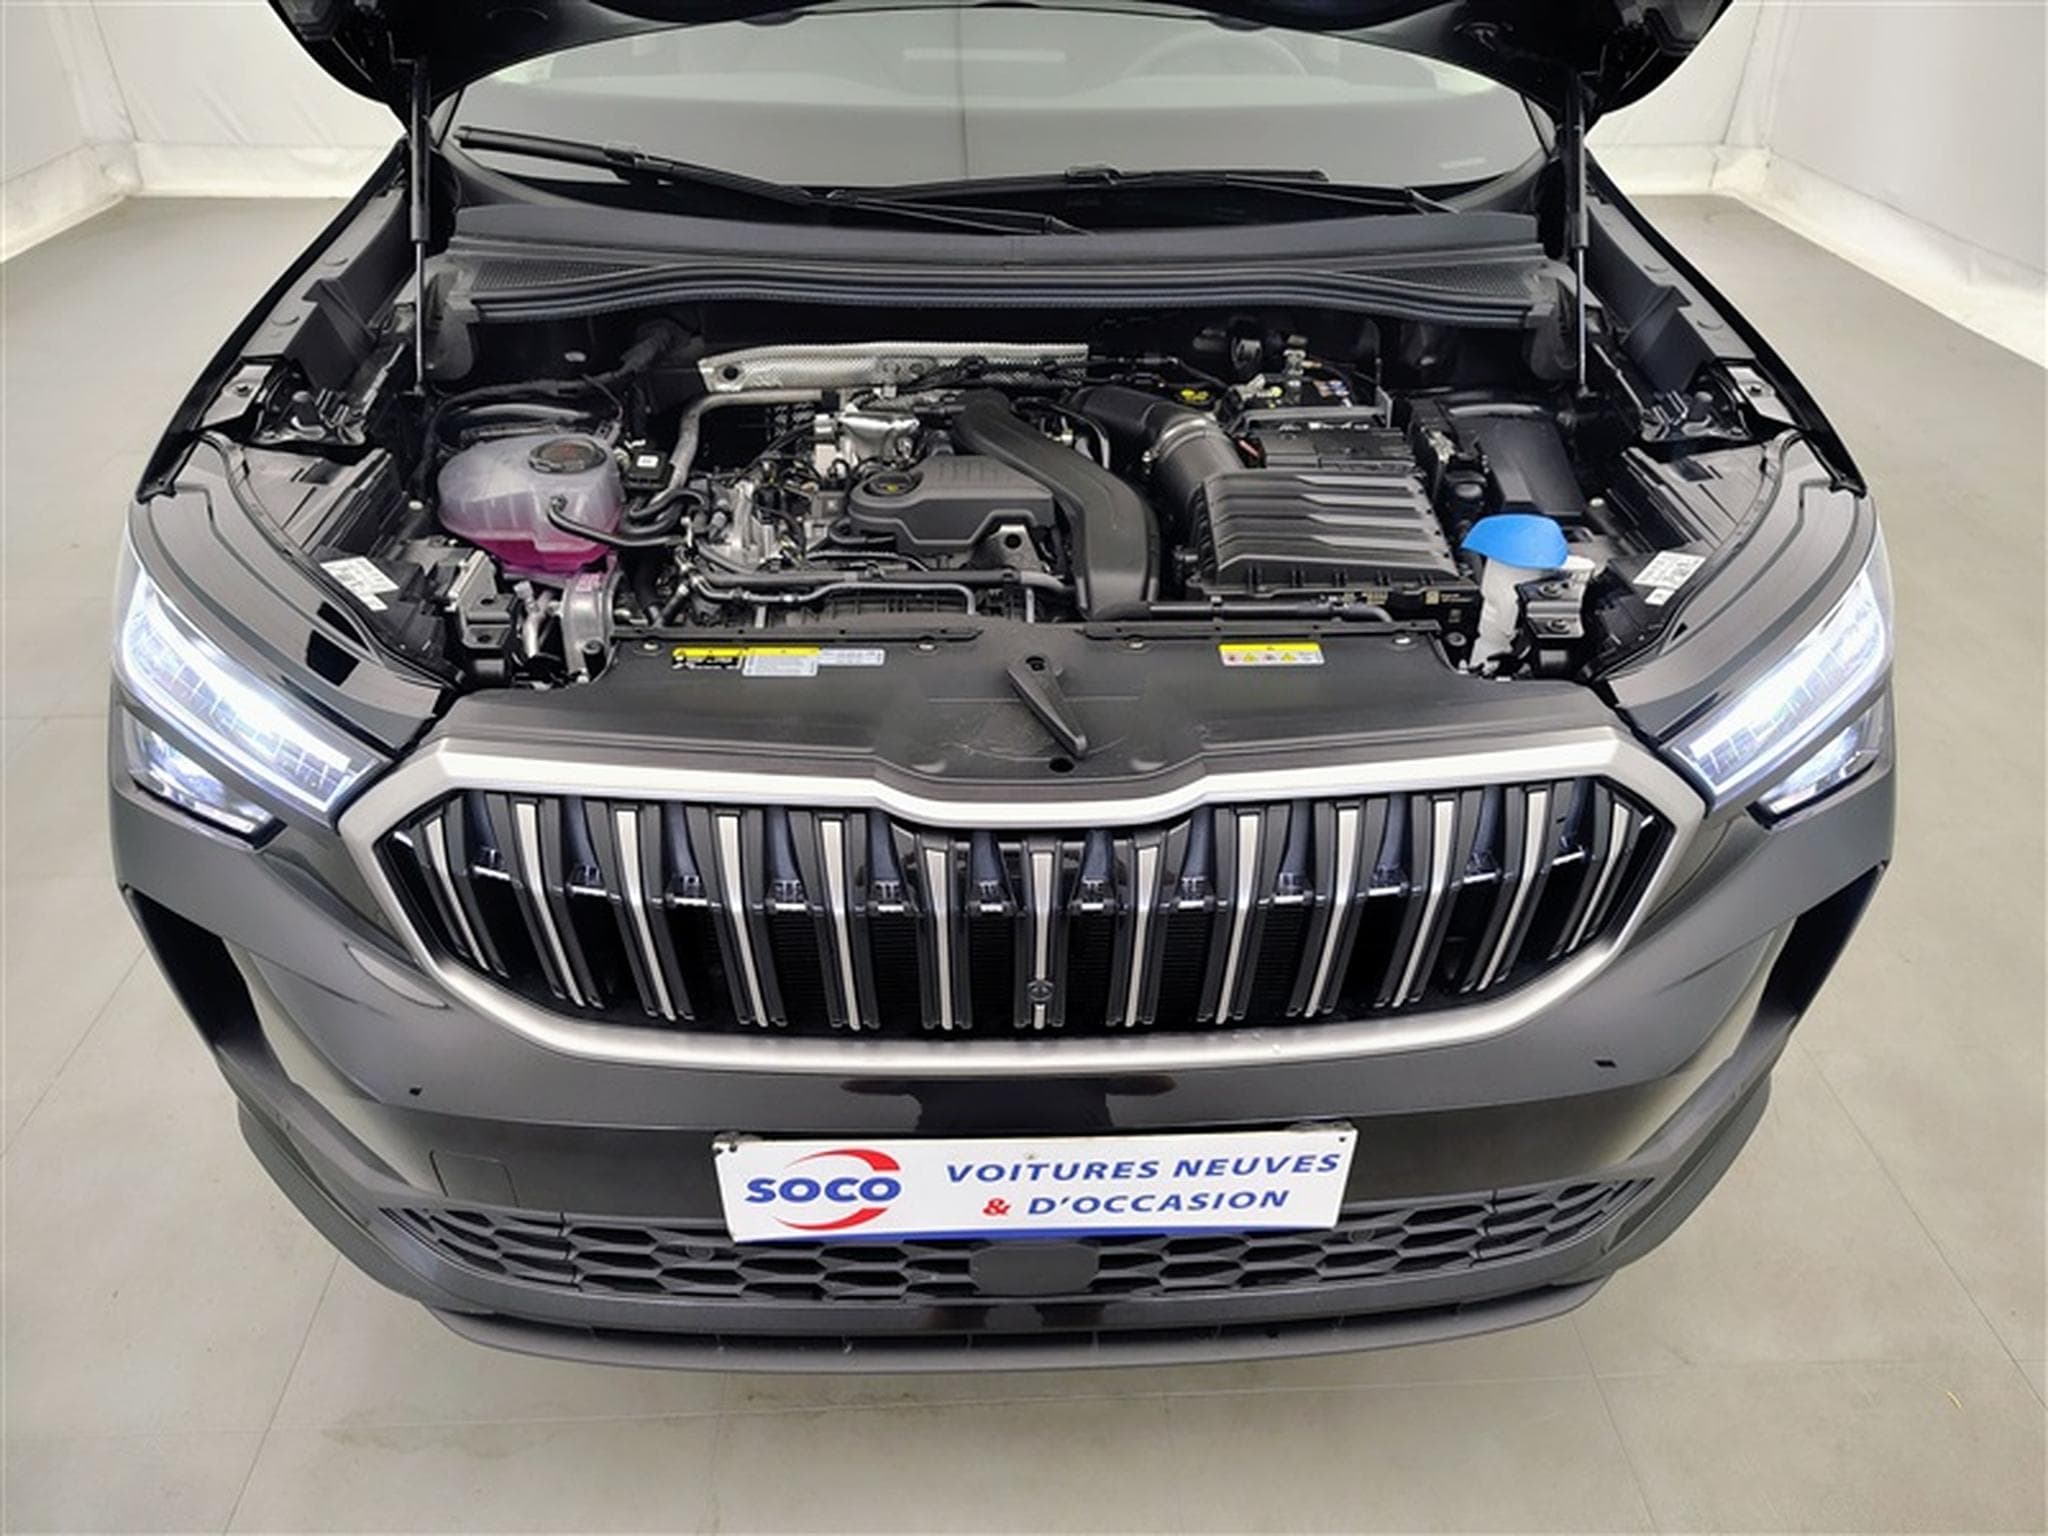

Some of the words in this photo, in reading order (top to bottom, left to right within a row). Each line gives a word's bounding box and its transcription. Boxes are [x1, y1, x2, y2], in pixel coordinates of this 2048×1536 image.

[947, 1161, 1159, 1182] VOITURES
[1173, 1154, 1340, 1177] NEUVES
[745, 1177, 901, 1203] SOCO
[983, 1198, 1011, 1216] &
[1028, 1190, 1289, 1215] D'OCCASION
